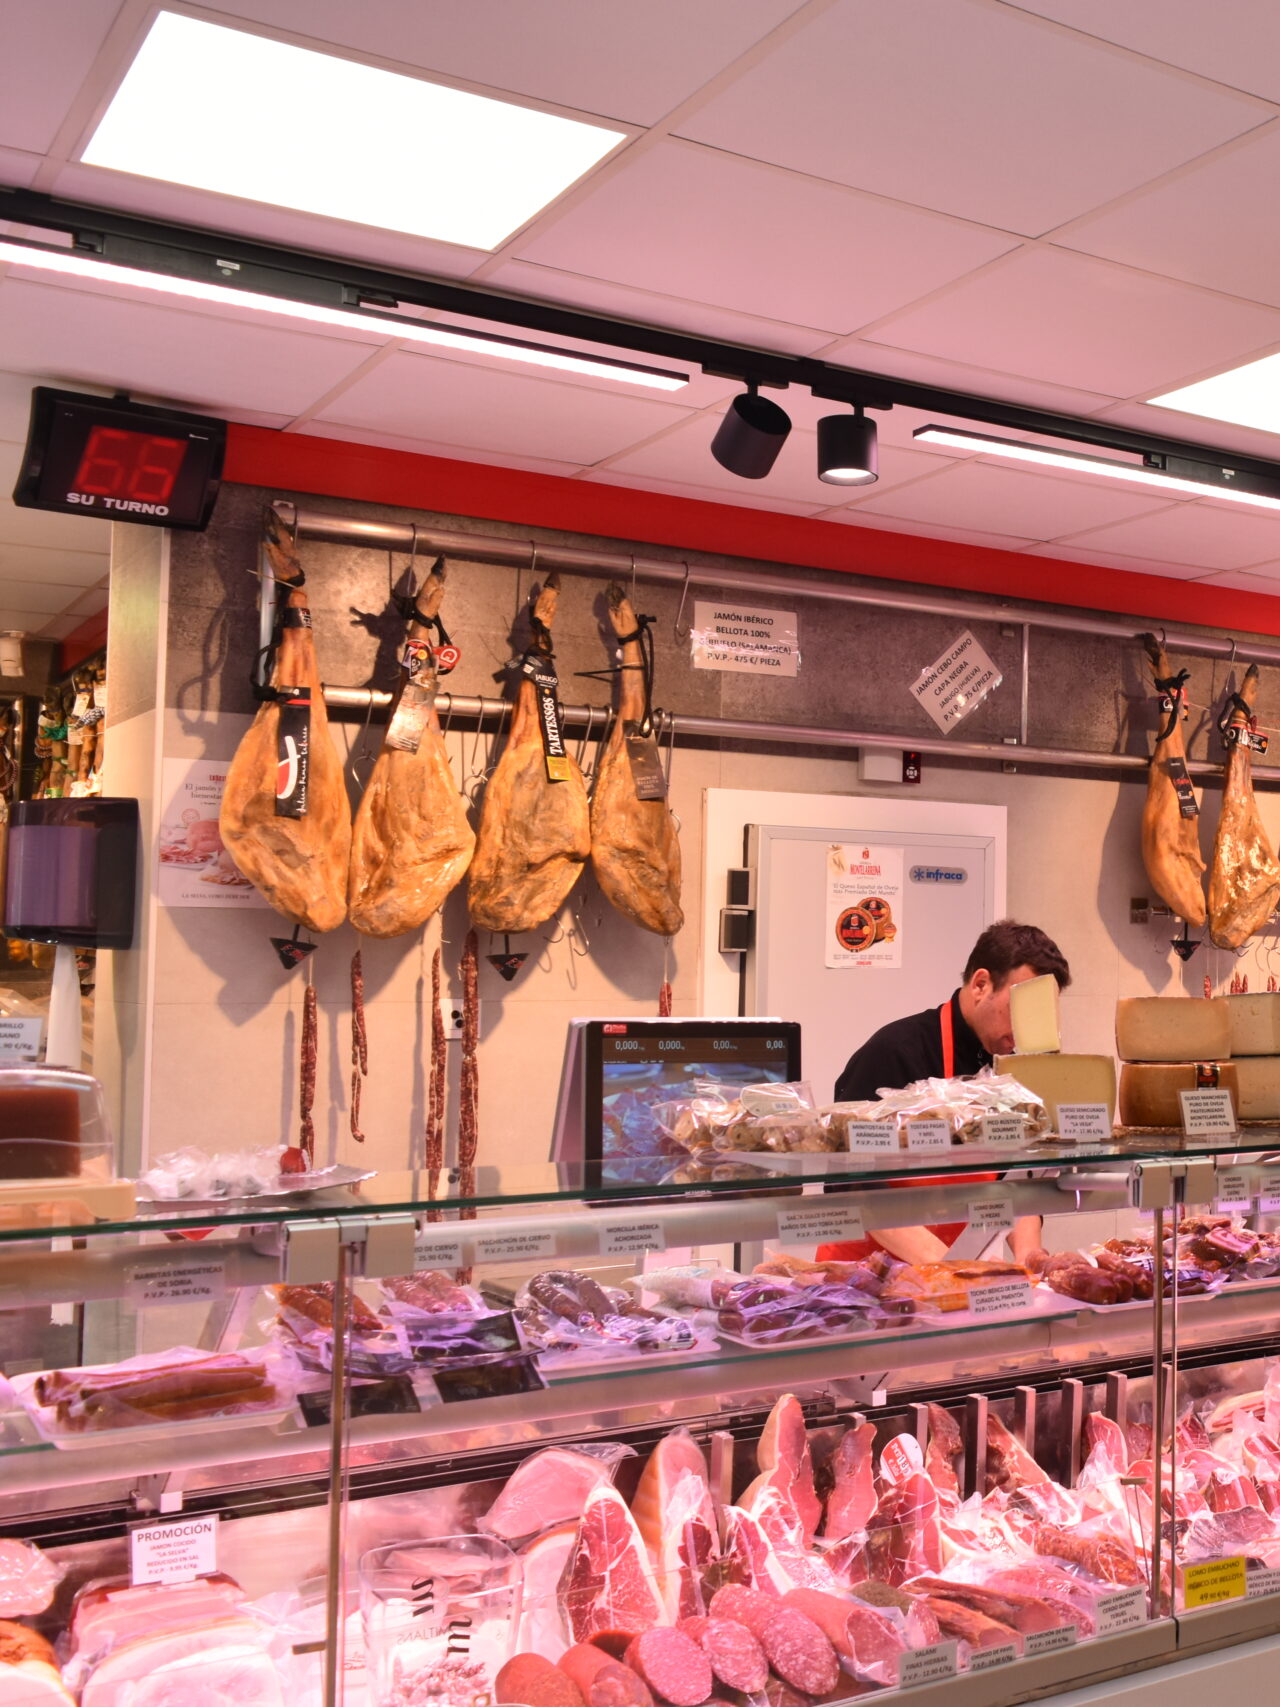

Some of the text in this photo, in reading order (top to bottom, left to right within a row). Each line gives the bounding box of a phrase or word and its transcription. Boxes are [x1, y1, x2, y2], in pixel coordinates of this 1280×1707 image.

[66, 492, 170, 516] SU TURNO
[714, 612, 774, 626] JAMÓN IBÉRICO
[716, 626, 771, 639] BELLOTA 100%
[734, 655, 748, 663] 475
[760, 658, 781, 667] PIEZA
[936, 658, 953, 676] CEBO
[951, 638, 973, 661] CAMPO
[535, 675, 558, 684] JABUGO
[934, 661, 969, 696] CAPA NEGRA
[940, 687, 960, 709] JABUGO
[542, 697, 563, 755] TARTESSOS
[926, 869, 963, 881] infraca
[435, 1243, 459, 1252] CIERVO
[134, 1270, 171, 1280] BARRITAS
[169, 1279, 193, 1287] SORIA
[1011, 1282, 1030, 1290] BELLOTA
[137, 1522, 212, 1542] PROMOCIÓN
[173, 1539, 197, 1547] COCIDO
[147, 1557, 178, 1567] REDUCIDO
[1189, 1568, 1207, 1577] LOMO
[1210, 1578, 1219, 1586] DE
[1219, 1573, 1244, 1584] BELLOTA
[1110, 1611, 1127, 1620] TERUEL
[905, 1655, 948, 1670] FINAS HIERBAS
